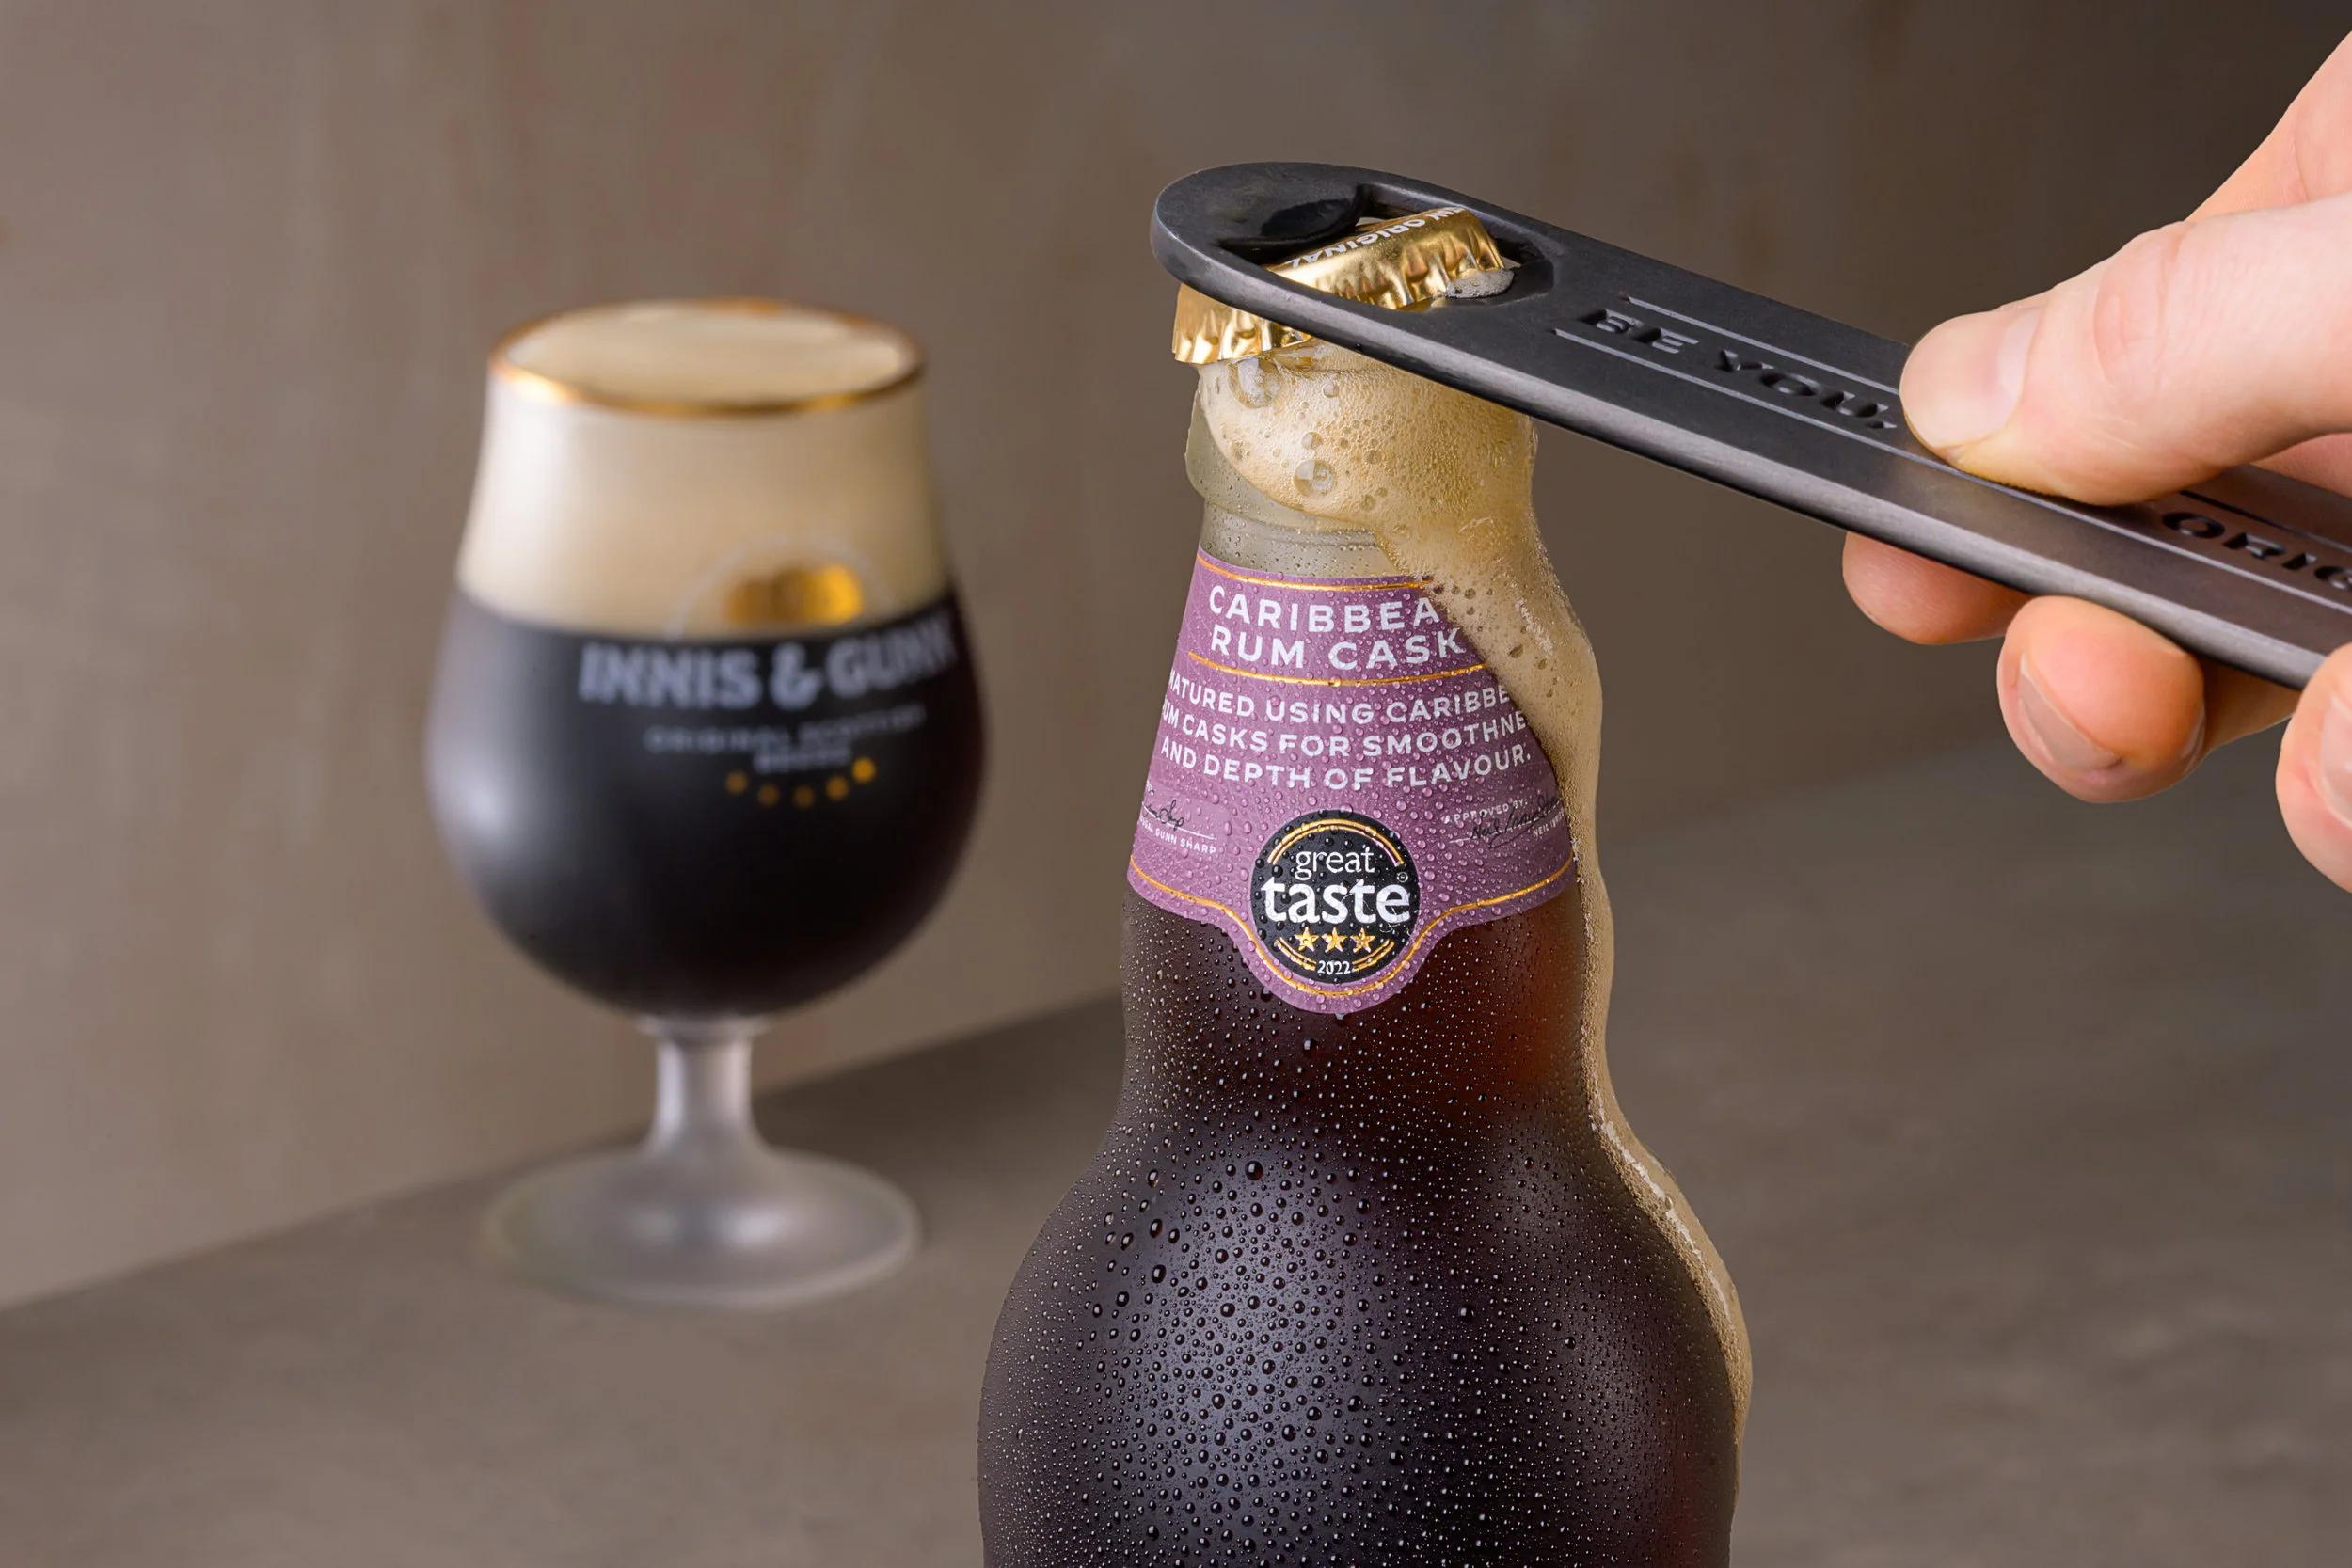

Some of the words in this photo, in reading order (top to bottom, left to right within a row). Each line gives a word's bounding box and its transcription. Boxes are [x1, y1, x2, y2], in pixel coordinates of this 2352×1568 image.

[1581, 308, 1699, 354] BE
[1209, 585, 1439, 633] CARIBBEA
[1211, 624, 1305, 669] RUM
[1328, 627, 1465, 670] CASK
[579, 641, 763, 710] INNIS
[769, 641, 823, 711] &
[1182, 713, 1268, 752] CASKS
[1279, 734, 1350, 757] FOR
[1266, 699, 1375, 725] USING
[1161, 736, 1197, 768] AND
[1203, 754, 1311, 788] DEPTH
[1324, 768, 1375, 790] OF
[1386, 744, 1531, 788] FLAVOUR.
[1180, 837, 1216, 854] SHARP
[1295, 846, 1376, 880] great
[1261, 876, 1411, 924] taste
[1317, 959, 1352, 975] 2022
